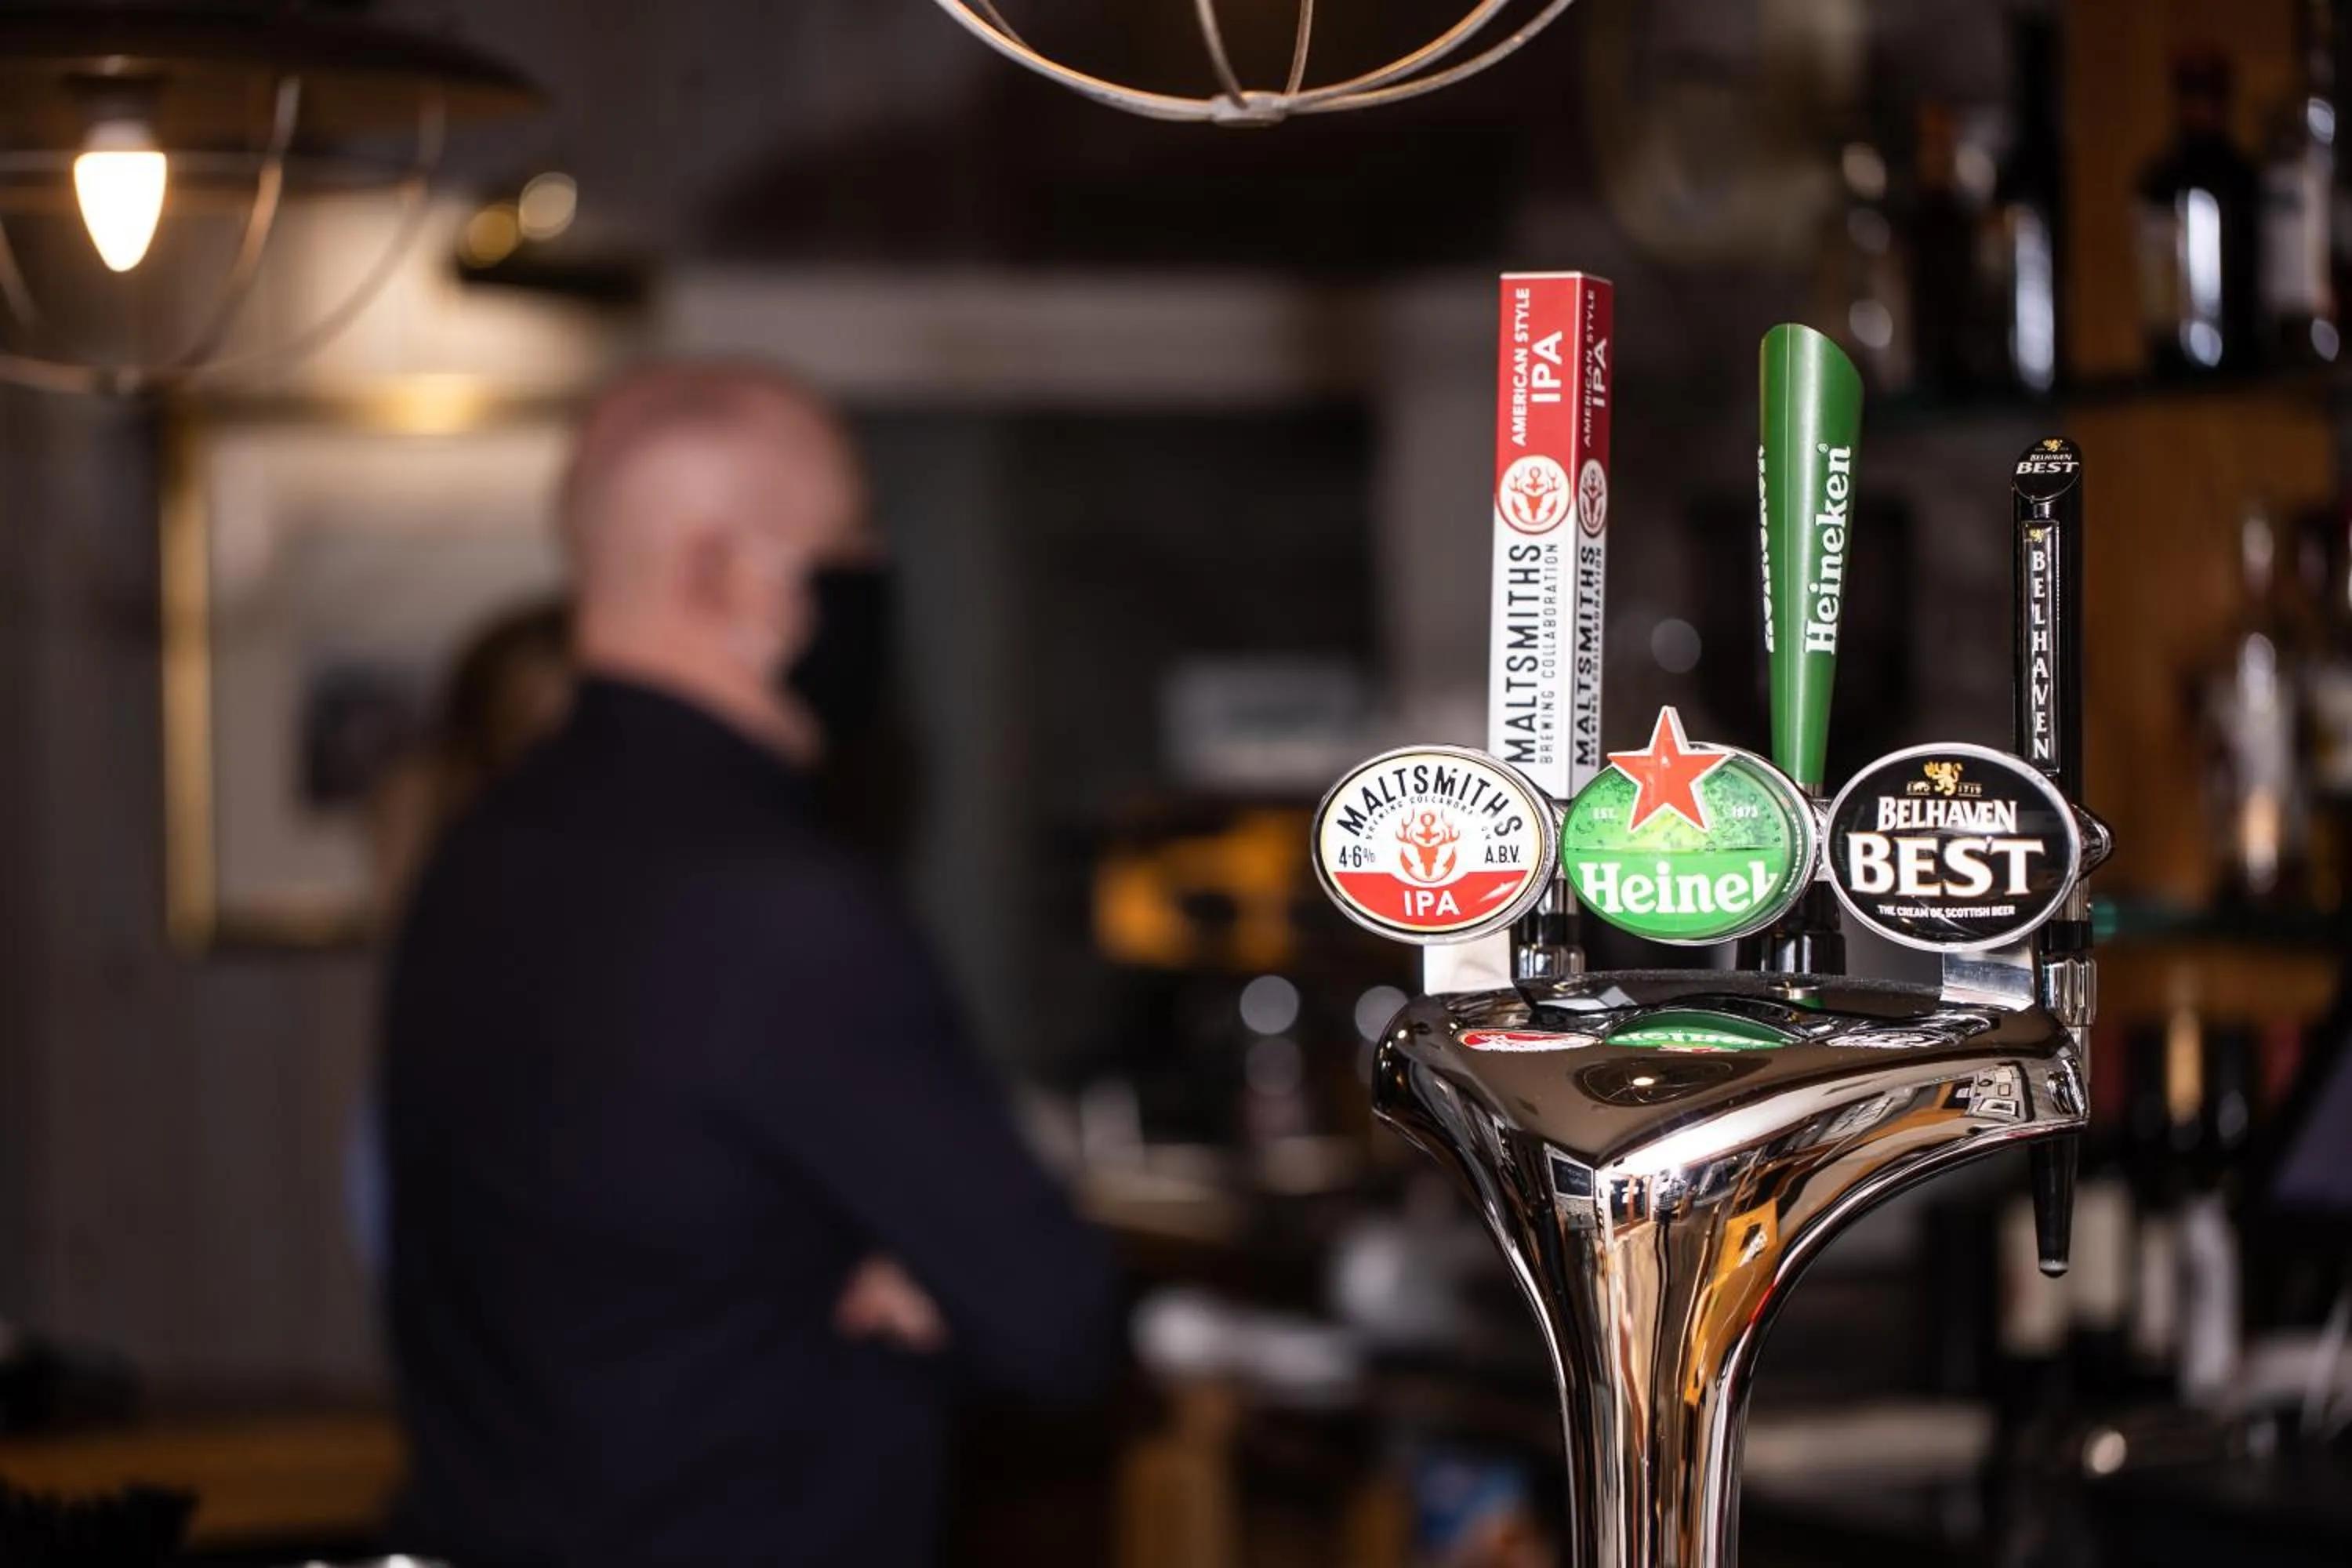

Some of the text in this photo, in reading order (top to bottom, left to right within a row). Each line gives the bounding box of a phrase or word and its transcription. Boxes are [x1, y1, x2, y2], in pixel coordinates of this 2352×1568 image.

[1512, 288, 1530, 446] AMERICAN STYLE
[1531, 331, 1563, 402] IPA
[1584, 290, 1595, 447] AMERICAN STYLE
[1592, 338, 1607, 407] IPA
[2016, 461, 2080, 474] BEST
[1504, 544, 1541, 763] MALTSMITHS
[1540, 543, 1559, 764] BREWING COLLABORATION
[1576, 546, 1595, 766] MALTSMITHS
[2032, 550, 2049, 759] BELHAVEN
[1336, 764, 1523, 837] MALTSMITHS
[1877, 796, 2016, 833] BELHAVEN
[1484, 844, 1521, 863] A.B.V.
[1846, 831, 2045, 898] BEST
[1403, 890, 1461, 916] IPA
[1878, 904, 1896, 916] THE
[1896, 906, 1929, 917] CREAM
[1944, 906, 1990, 917] SCOTTISH
[1991, 905, 2016, 916] BEER
